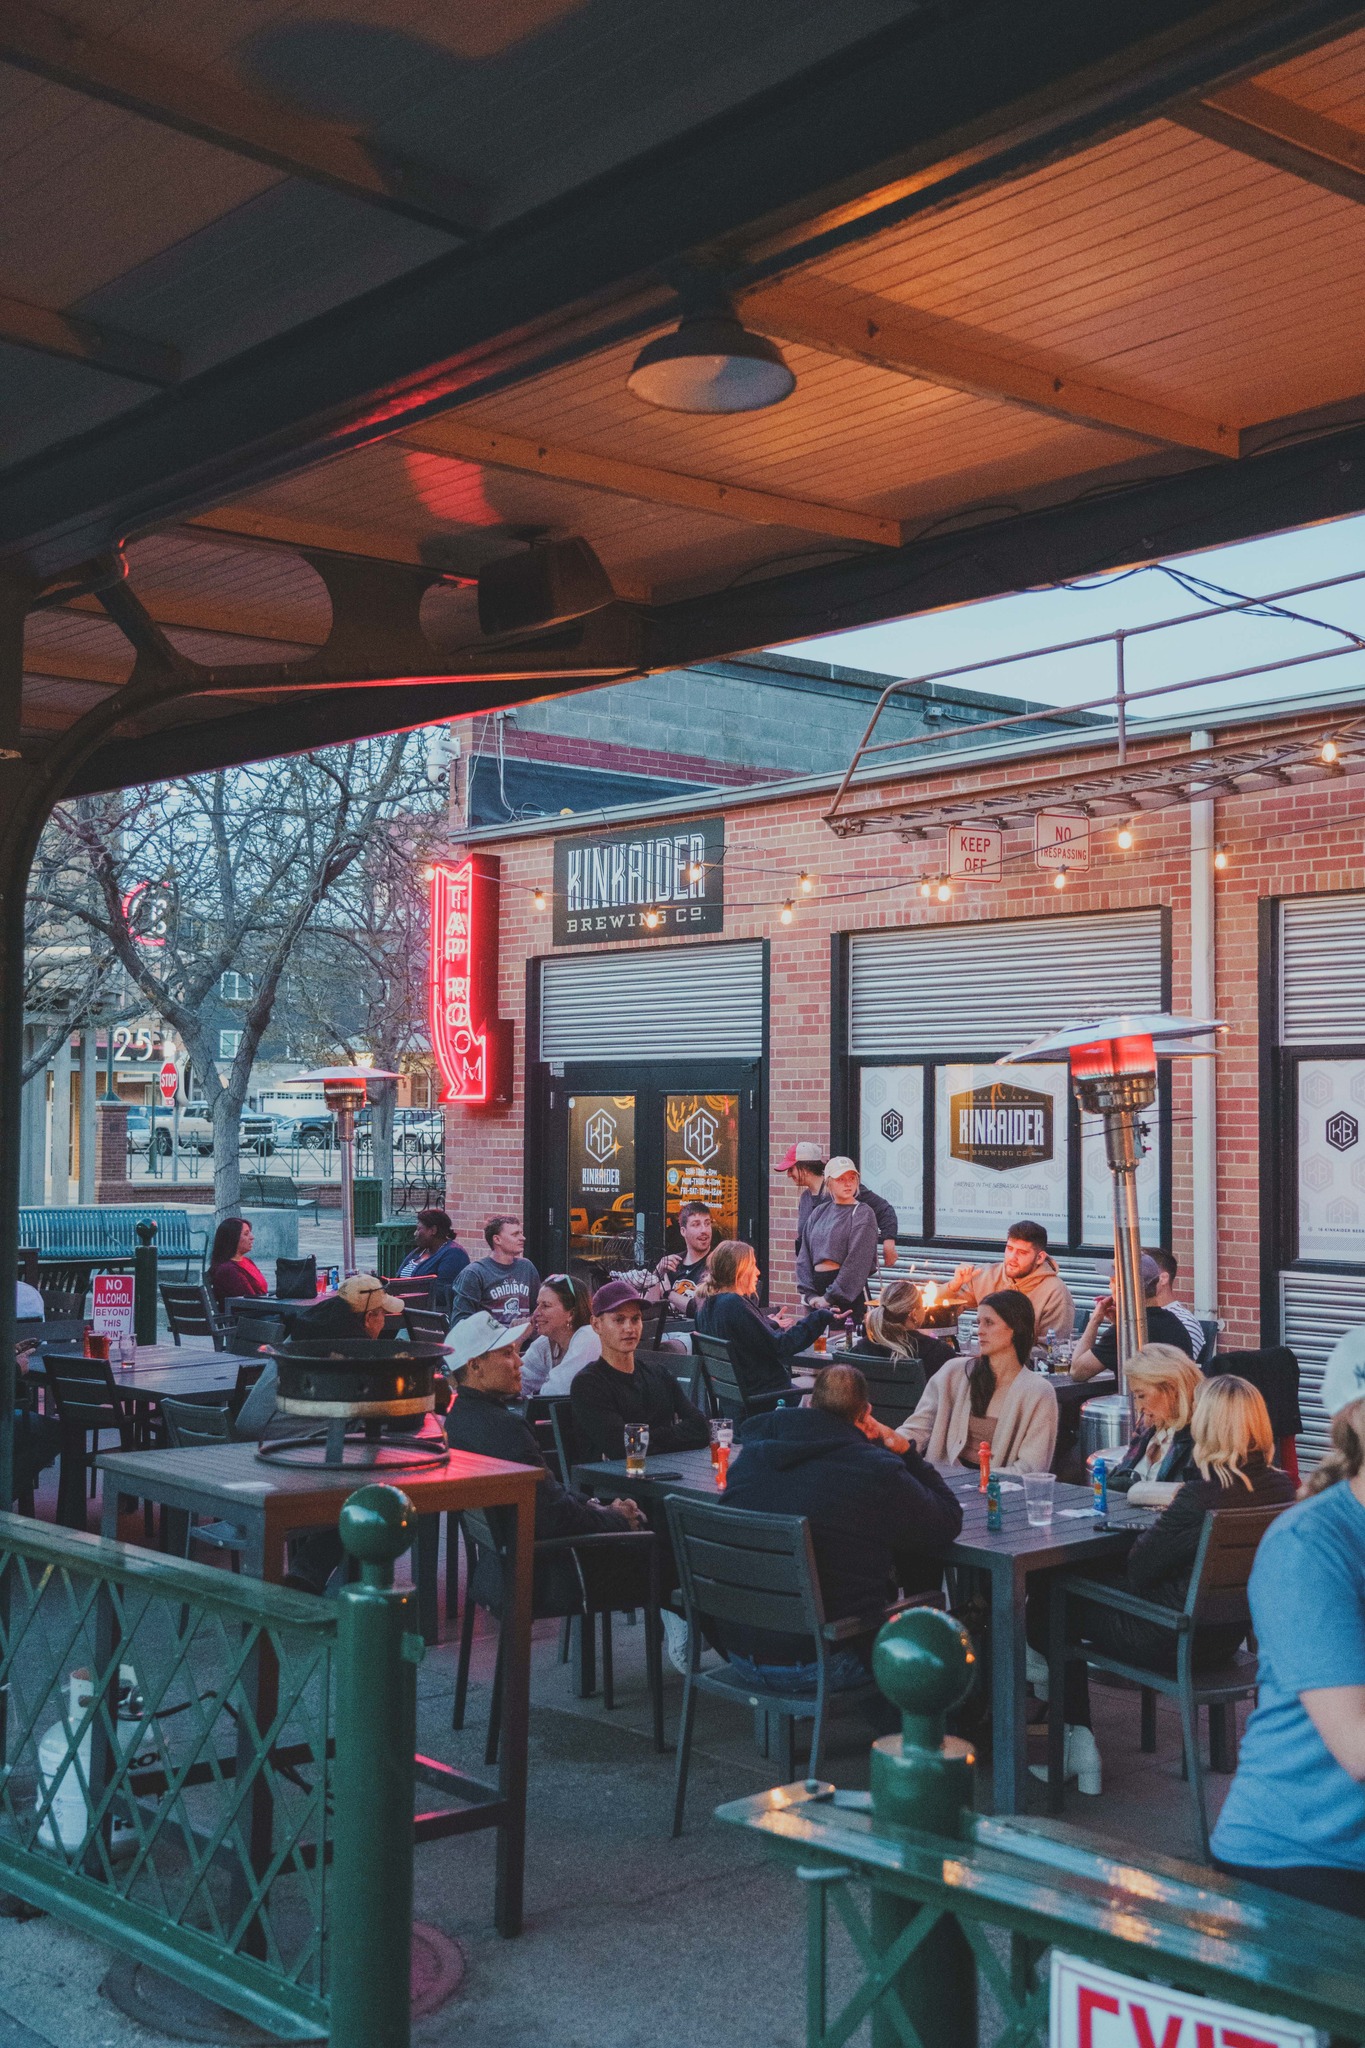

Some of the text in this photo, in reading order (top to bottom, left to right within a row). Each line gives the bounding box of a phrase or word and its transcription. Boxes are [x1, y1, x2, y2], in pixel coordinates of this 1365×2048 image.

[1055, 826, 1072, 842] NO
[960, 836, 991, 853] KEEP
[1040, 847, 1087, 861] TRESPASSING
[567, 833, 706, 912] KINKAIDER
[964, 857, 987, 874] OFF
[567, 911, 667, 933] BREWING
[446, 884, 482, 1082] TAP ROOM
[114, 1026, 153, 1062] 25
[161, 1073, 177, 1087] STOP
[959, 1109, 1044, 1146] KINKAIDER
[582, 1167, 620, 1185] KINKAIDER
[106, 1279, 123, 1291] NO
[96, 1293, 131, 1304] ALCOHOL
[96, 1308, 130, 1316] BEYOND
[103, 1319, 121, 1327] THIS
